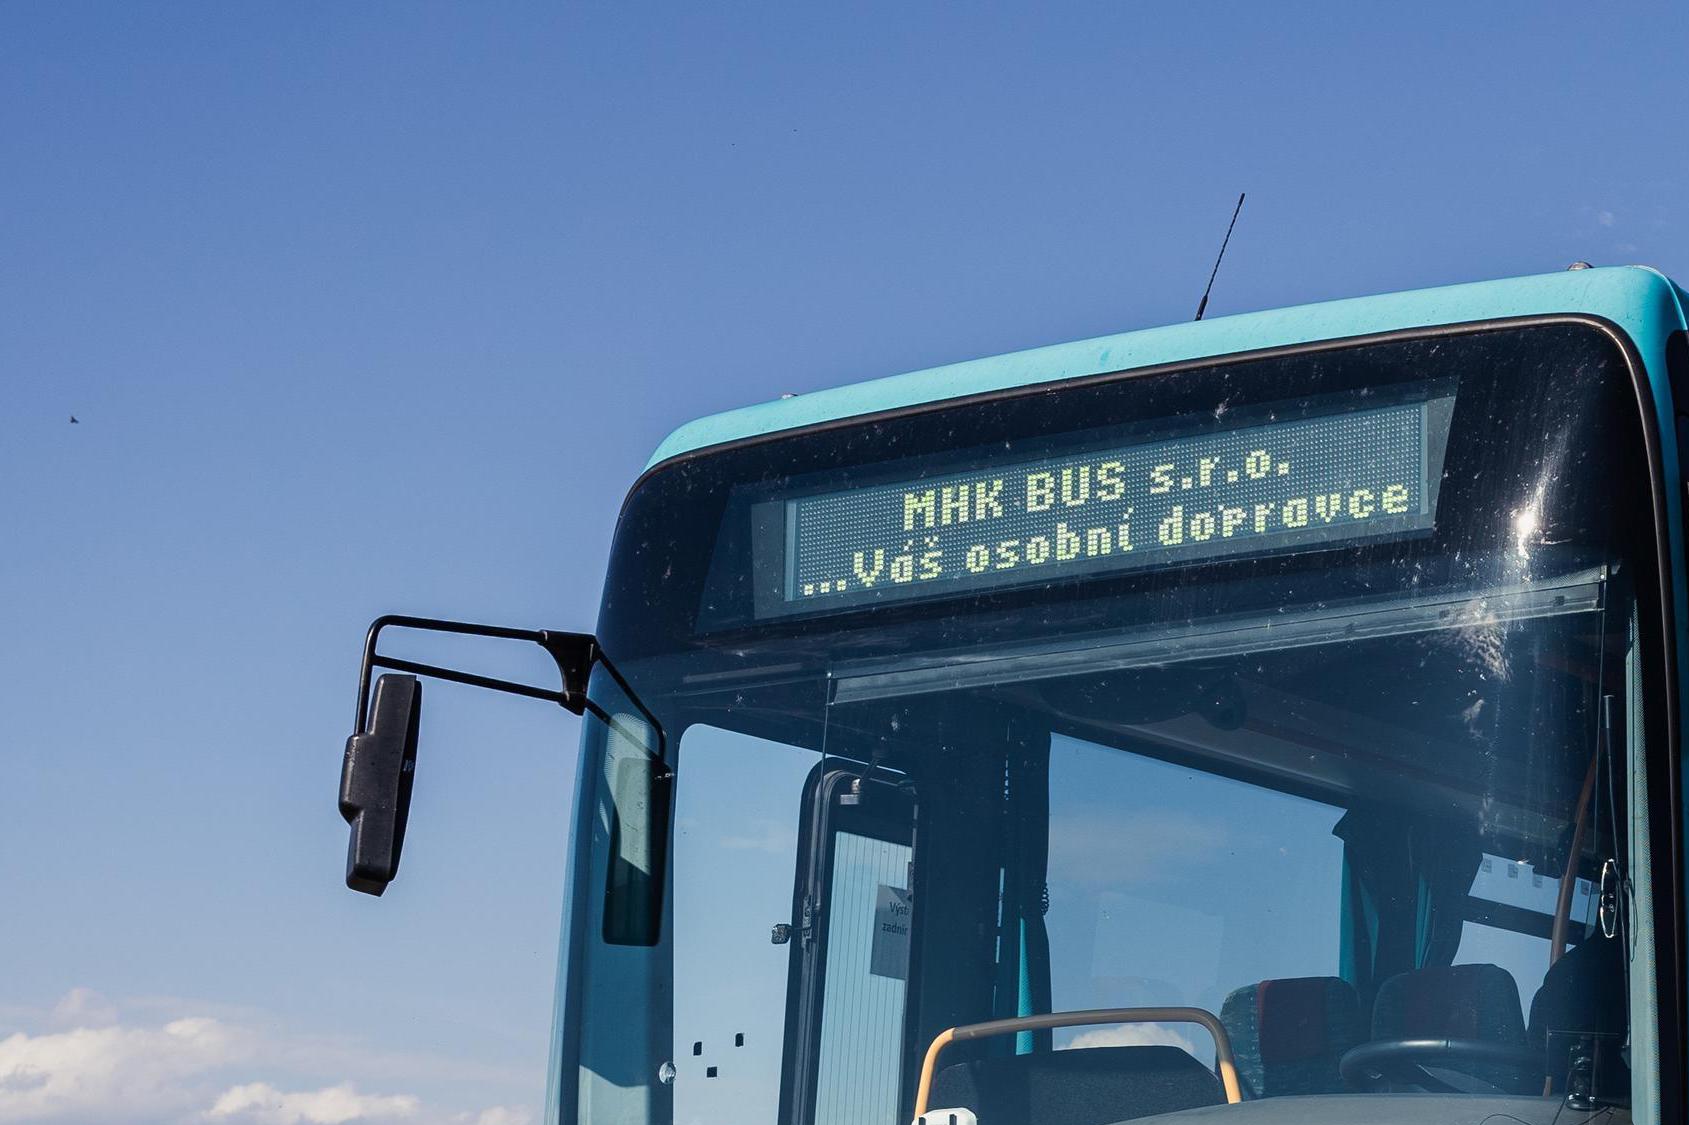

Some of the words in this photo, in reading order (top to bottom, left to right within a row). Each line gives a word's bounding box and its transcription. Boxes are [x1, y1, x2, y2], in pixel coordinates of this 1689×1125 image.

[903, 479, 1003, 532] MHK
[1026, 461, 1125, 512] BUS
[1150, 449, 1290, 495] s.r.o.
[965, 506, 1134, 573] osobní
[1158, 484, 1409, 546] dopravce
